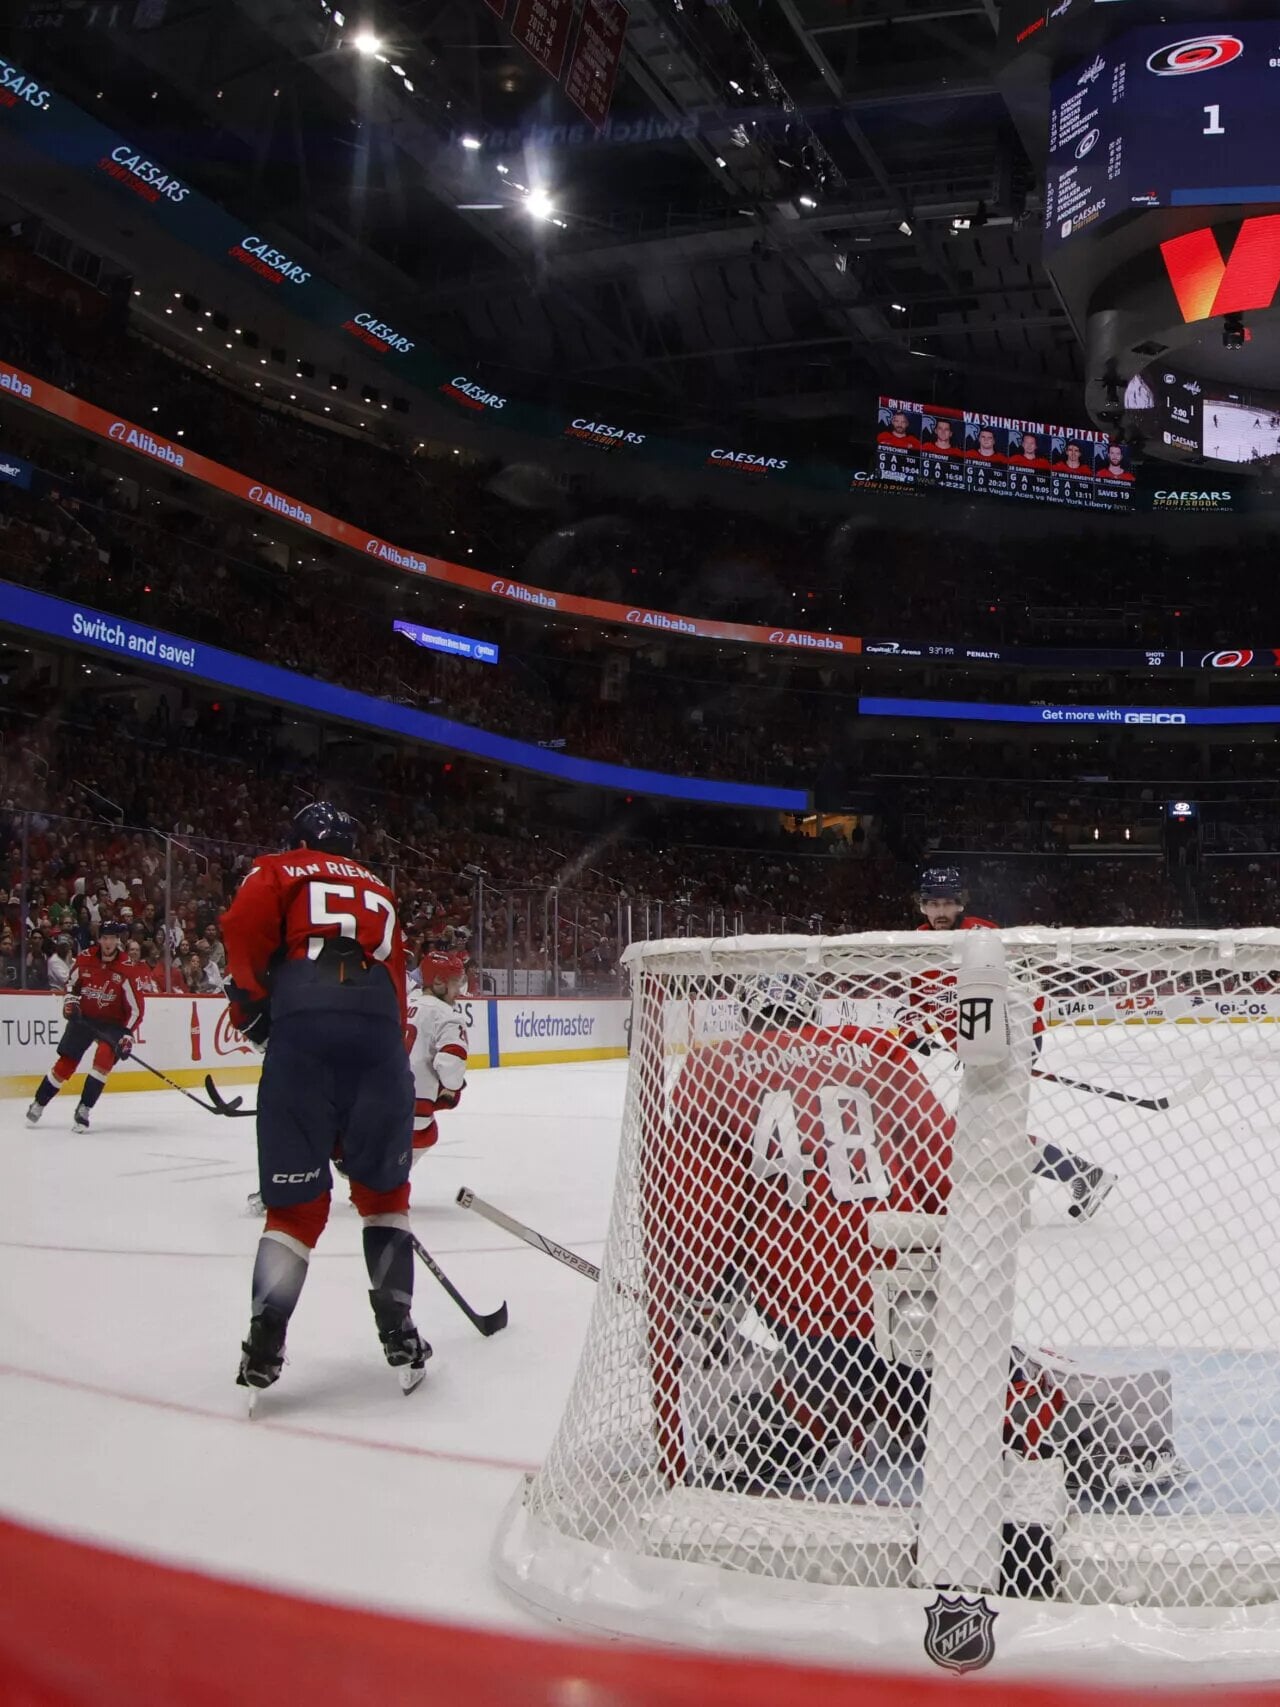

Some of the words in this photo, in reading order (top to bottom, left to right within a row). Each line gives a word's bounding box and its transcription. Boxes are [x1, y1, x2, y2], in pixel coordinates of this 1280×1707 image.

[1203, 105, 1225, 135] 1
[111, 146, 190, 202] CAESARS
[1073, 198, 1106, 225] CAESARS
[241, 236, 311, 284] CAESARS
[354, 313, 415, 353] CAESARS
[451, 376, 506, 409] CAESARS
[888, 398, 898, 409] ON
[899, 400, 912, 412] THE
[912, 402, 924, 414] ICE
[571, 418, 646, 445] CAESARS
[962, 411, 1044, 435] WASHINGTON
[1049, 425, 1110, 444] CAPITALS
[125, 428, 185, 468] Alibaba
[710, 449, 788, 470] CAESARS
[263, 491, 313, 525] Alibaba
[1014, 491, 1034, 500] Aces
[1046, 495, 1064, 504] New
[1066, 498, 1083, 506] York
[1084, 500, 1115, 510] Liberty
[1098, 489, 1118, 498] SAVES
[1120, 491, 1130, 500] 19
[1153, 499, 1218, 507] SPORTSBOOK
[1154, 490, 1232, 500] CAESARS
[378, 546, 428, 574] Alibaba
[505, 583, 557, 609] Alibaba
[642, 613, 696, 634] Alibaba
[71, 613, 126, 650] Switch
[128, 631, 157, 657] and
[158, 643, 196, 668] save!
[786, 632, 844, 650] Alibaba
[1148, 657, 1161, 666] 20
[1042, 709, 1063, 720] Get
[1065, 711, 1095, 721] more
[1097, 710, 1122, 721] with
[1124, 713, 1186, 724] GEICO
[282, 863, 321, 877] VAN
[308, 881, 396, 962] 57
[514, 1011, 595, 1038] ticketmaster
[751, 1085, 891, 1207] 48
[272, 1168, 321, 1185] CCM
[941, 1618, 980, 1655] NHL
